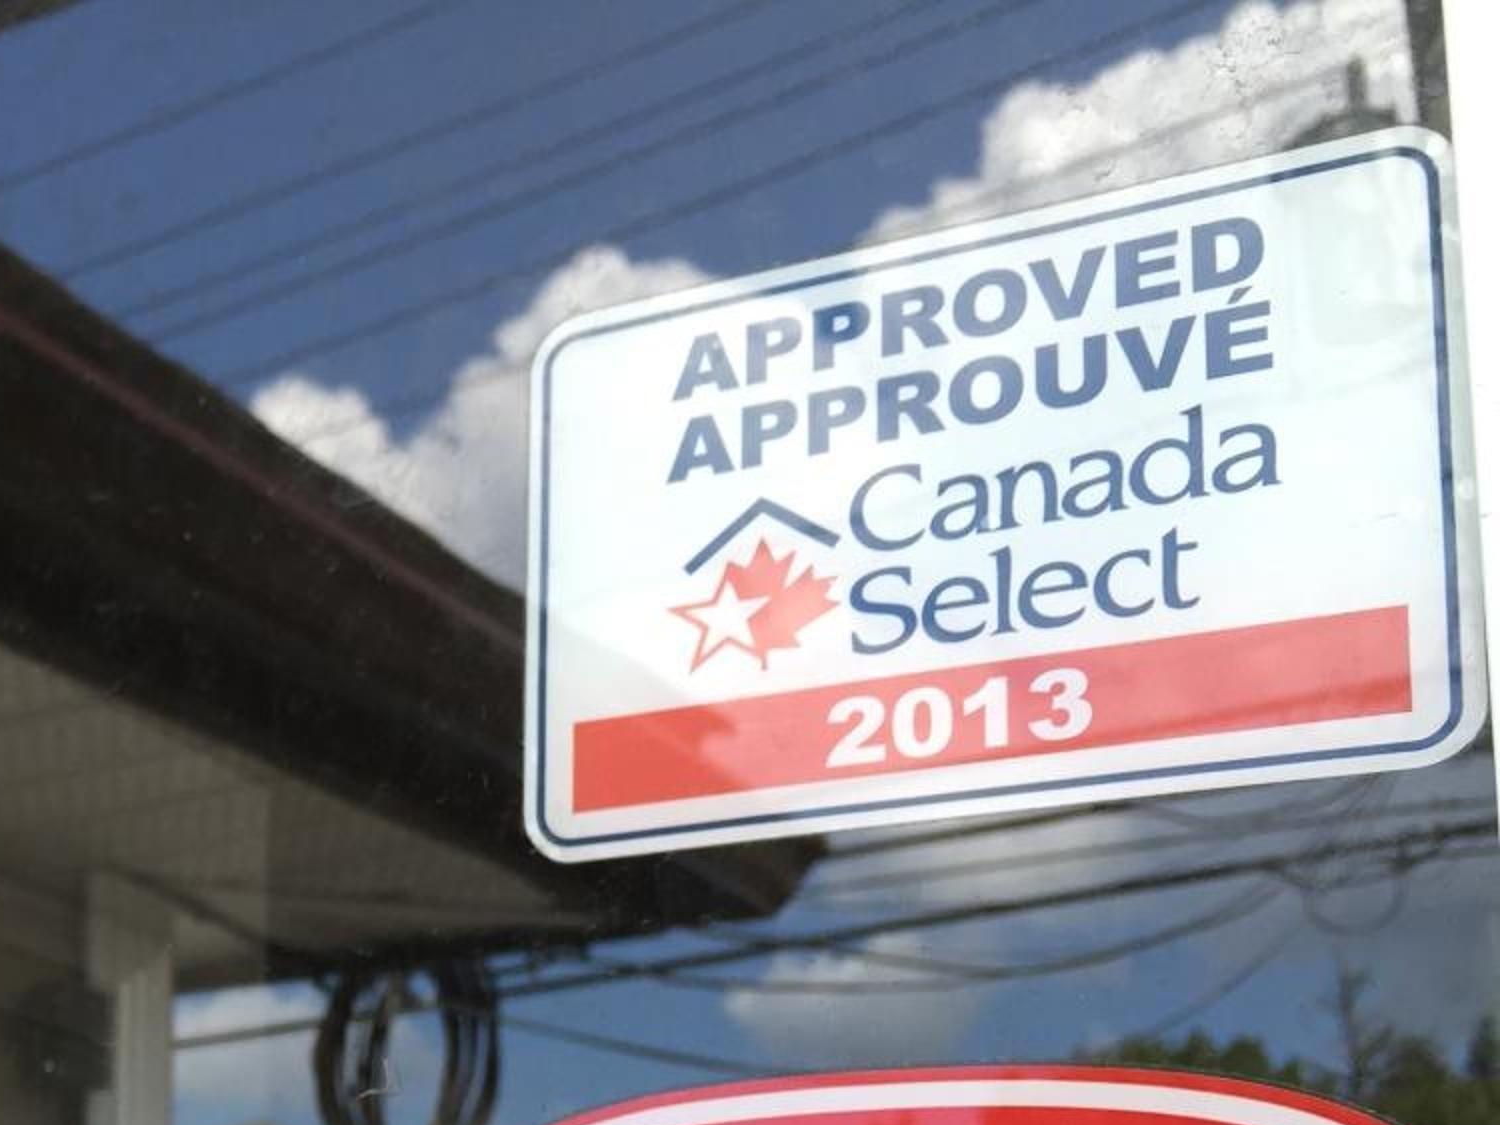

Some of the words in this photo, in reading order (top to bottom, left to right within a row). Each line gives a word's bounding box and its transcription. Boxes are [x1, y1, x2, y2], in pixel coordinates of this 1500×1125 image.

[671, 216, 1265, 401] APPROVED
[666, 286, 1274, 485] APPROUVÉ
[848, 405, 1282, 551] Canada
[850, 527, 1200, 656] Select
[825, 667, 1092, 768] 2013
